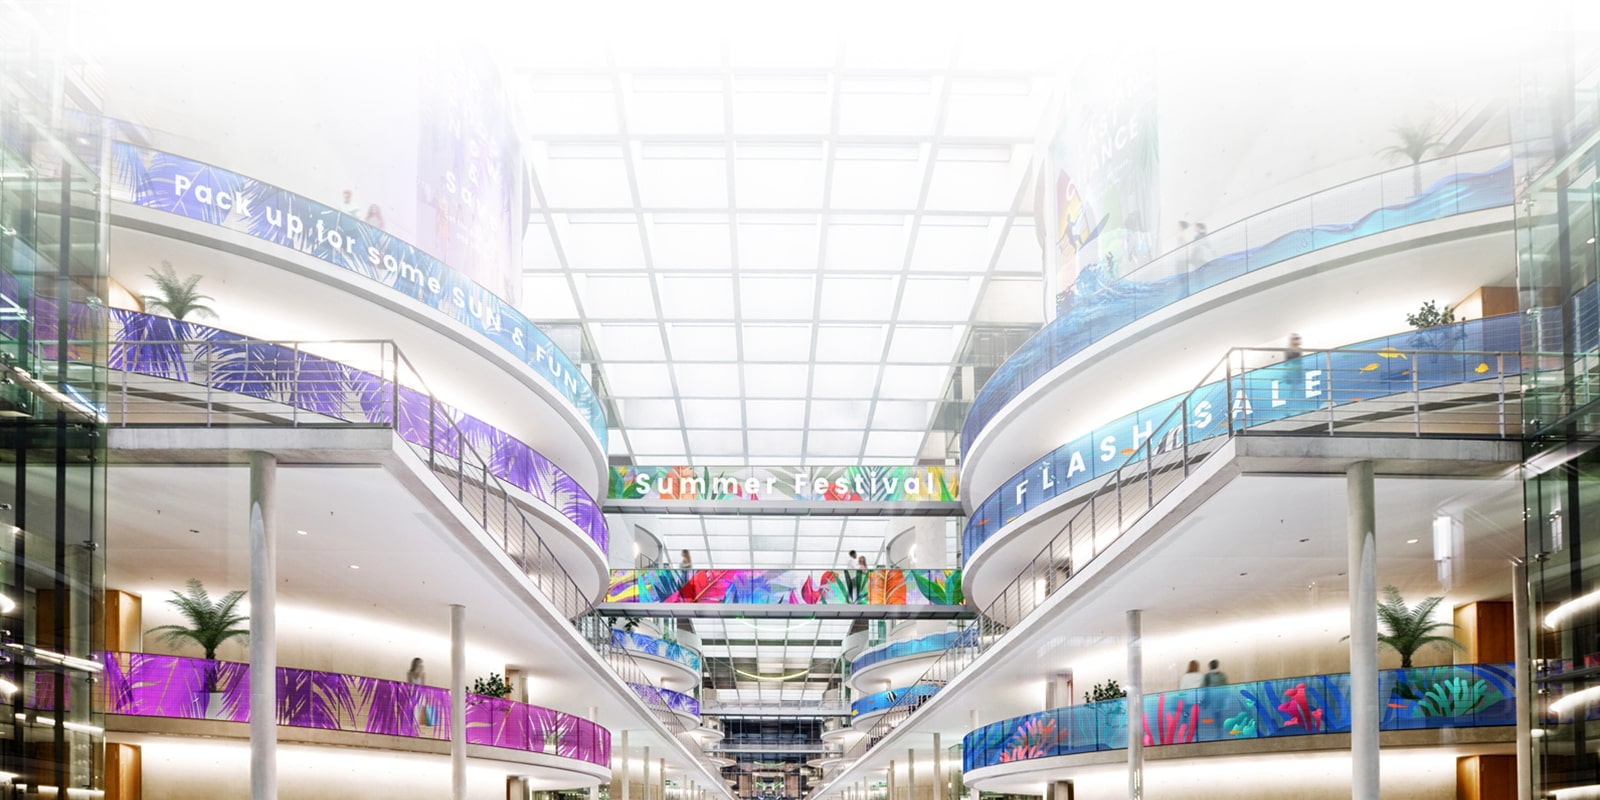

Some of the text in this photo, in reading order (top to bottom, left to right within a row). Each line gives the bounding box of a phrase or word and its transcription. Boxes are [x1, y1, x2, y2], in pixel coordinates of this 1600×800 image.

[175, 174, 251, 217] Pack
[266, 206, 303, 239] up
[368, 246, 441, 294] some
[453, 287, 501, 332] SUN
[511, 327, 526, 350] &
[536, 345, 578, 394] FUN
[636, 472, 934, 495] Summer Festival
[1016, 370, 1322, 505] FLASH SALE
